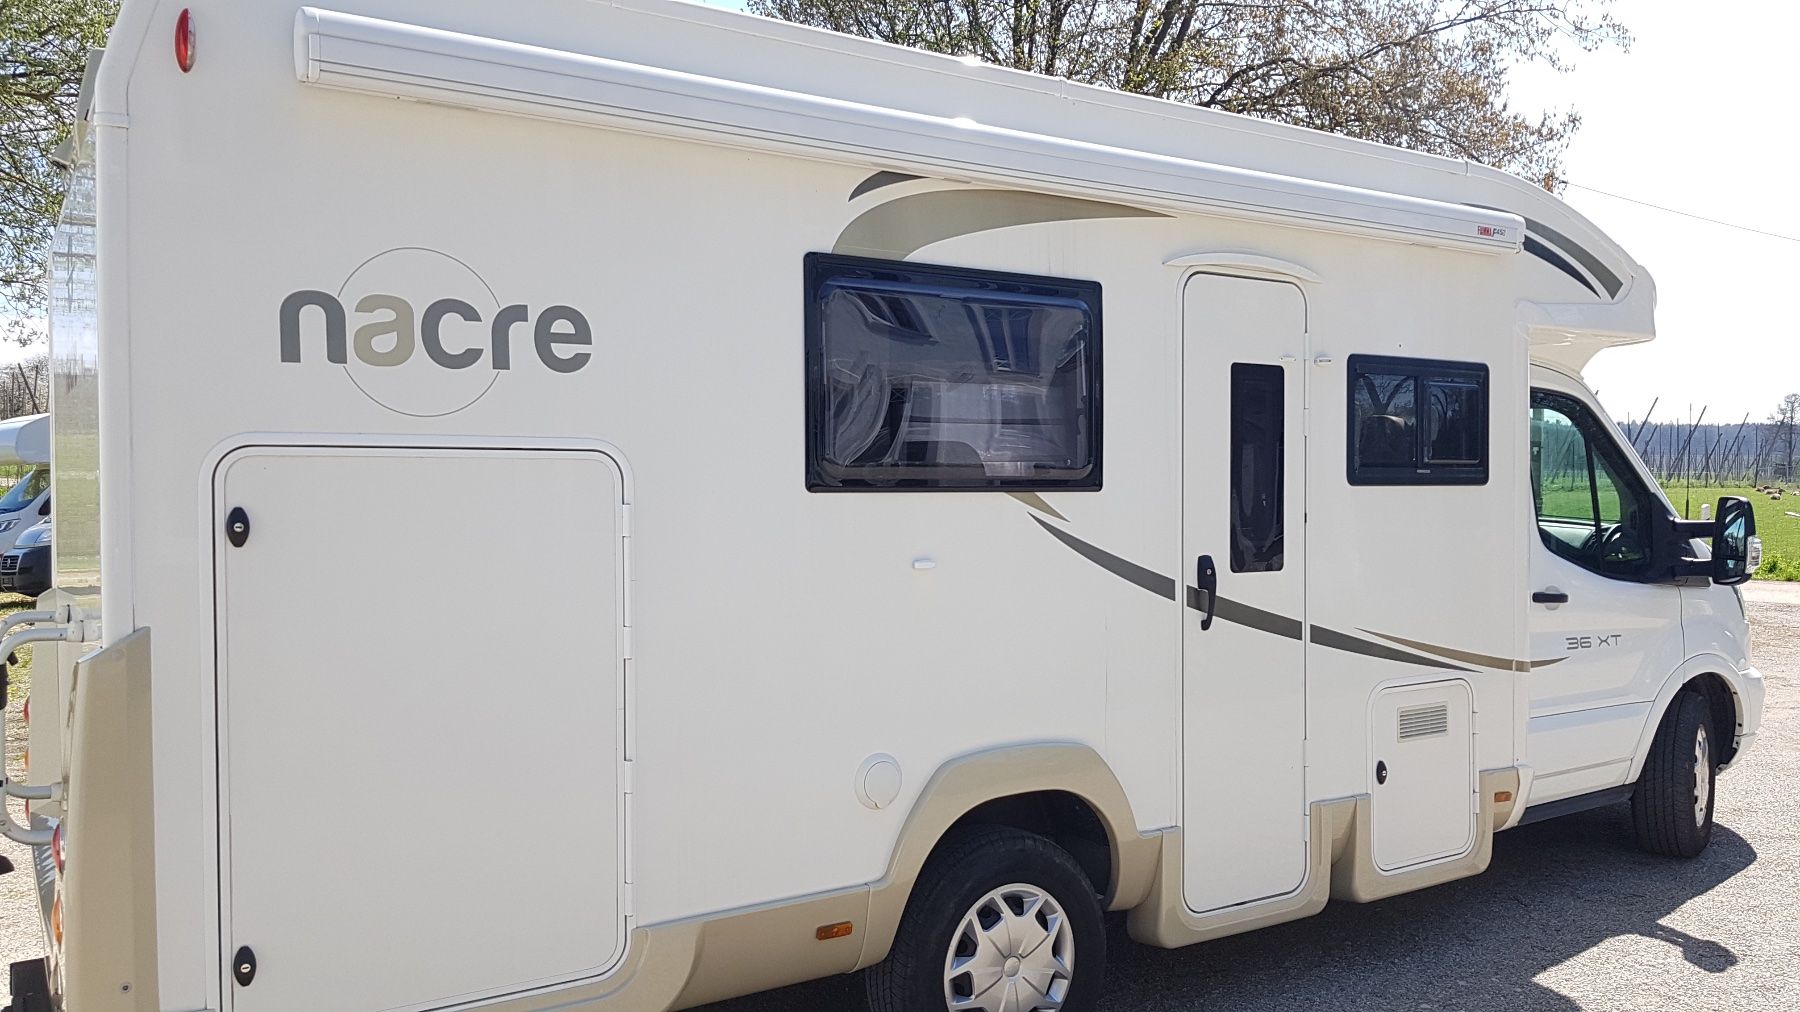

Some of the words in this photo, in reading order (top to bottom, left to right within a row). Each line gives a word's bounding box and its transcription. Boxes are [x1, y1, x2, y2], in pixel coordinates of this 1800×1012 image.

[279, 290, 593, 374] nacre
[1565, 636, 1592, 650] 36
[1597, 634, 1622, 648] XT
